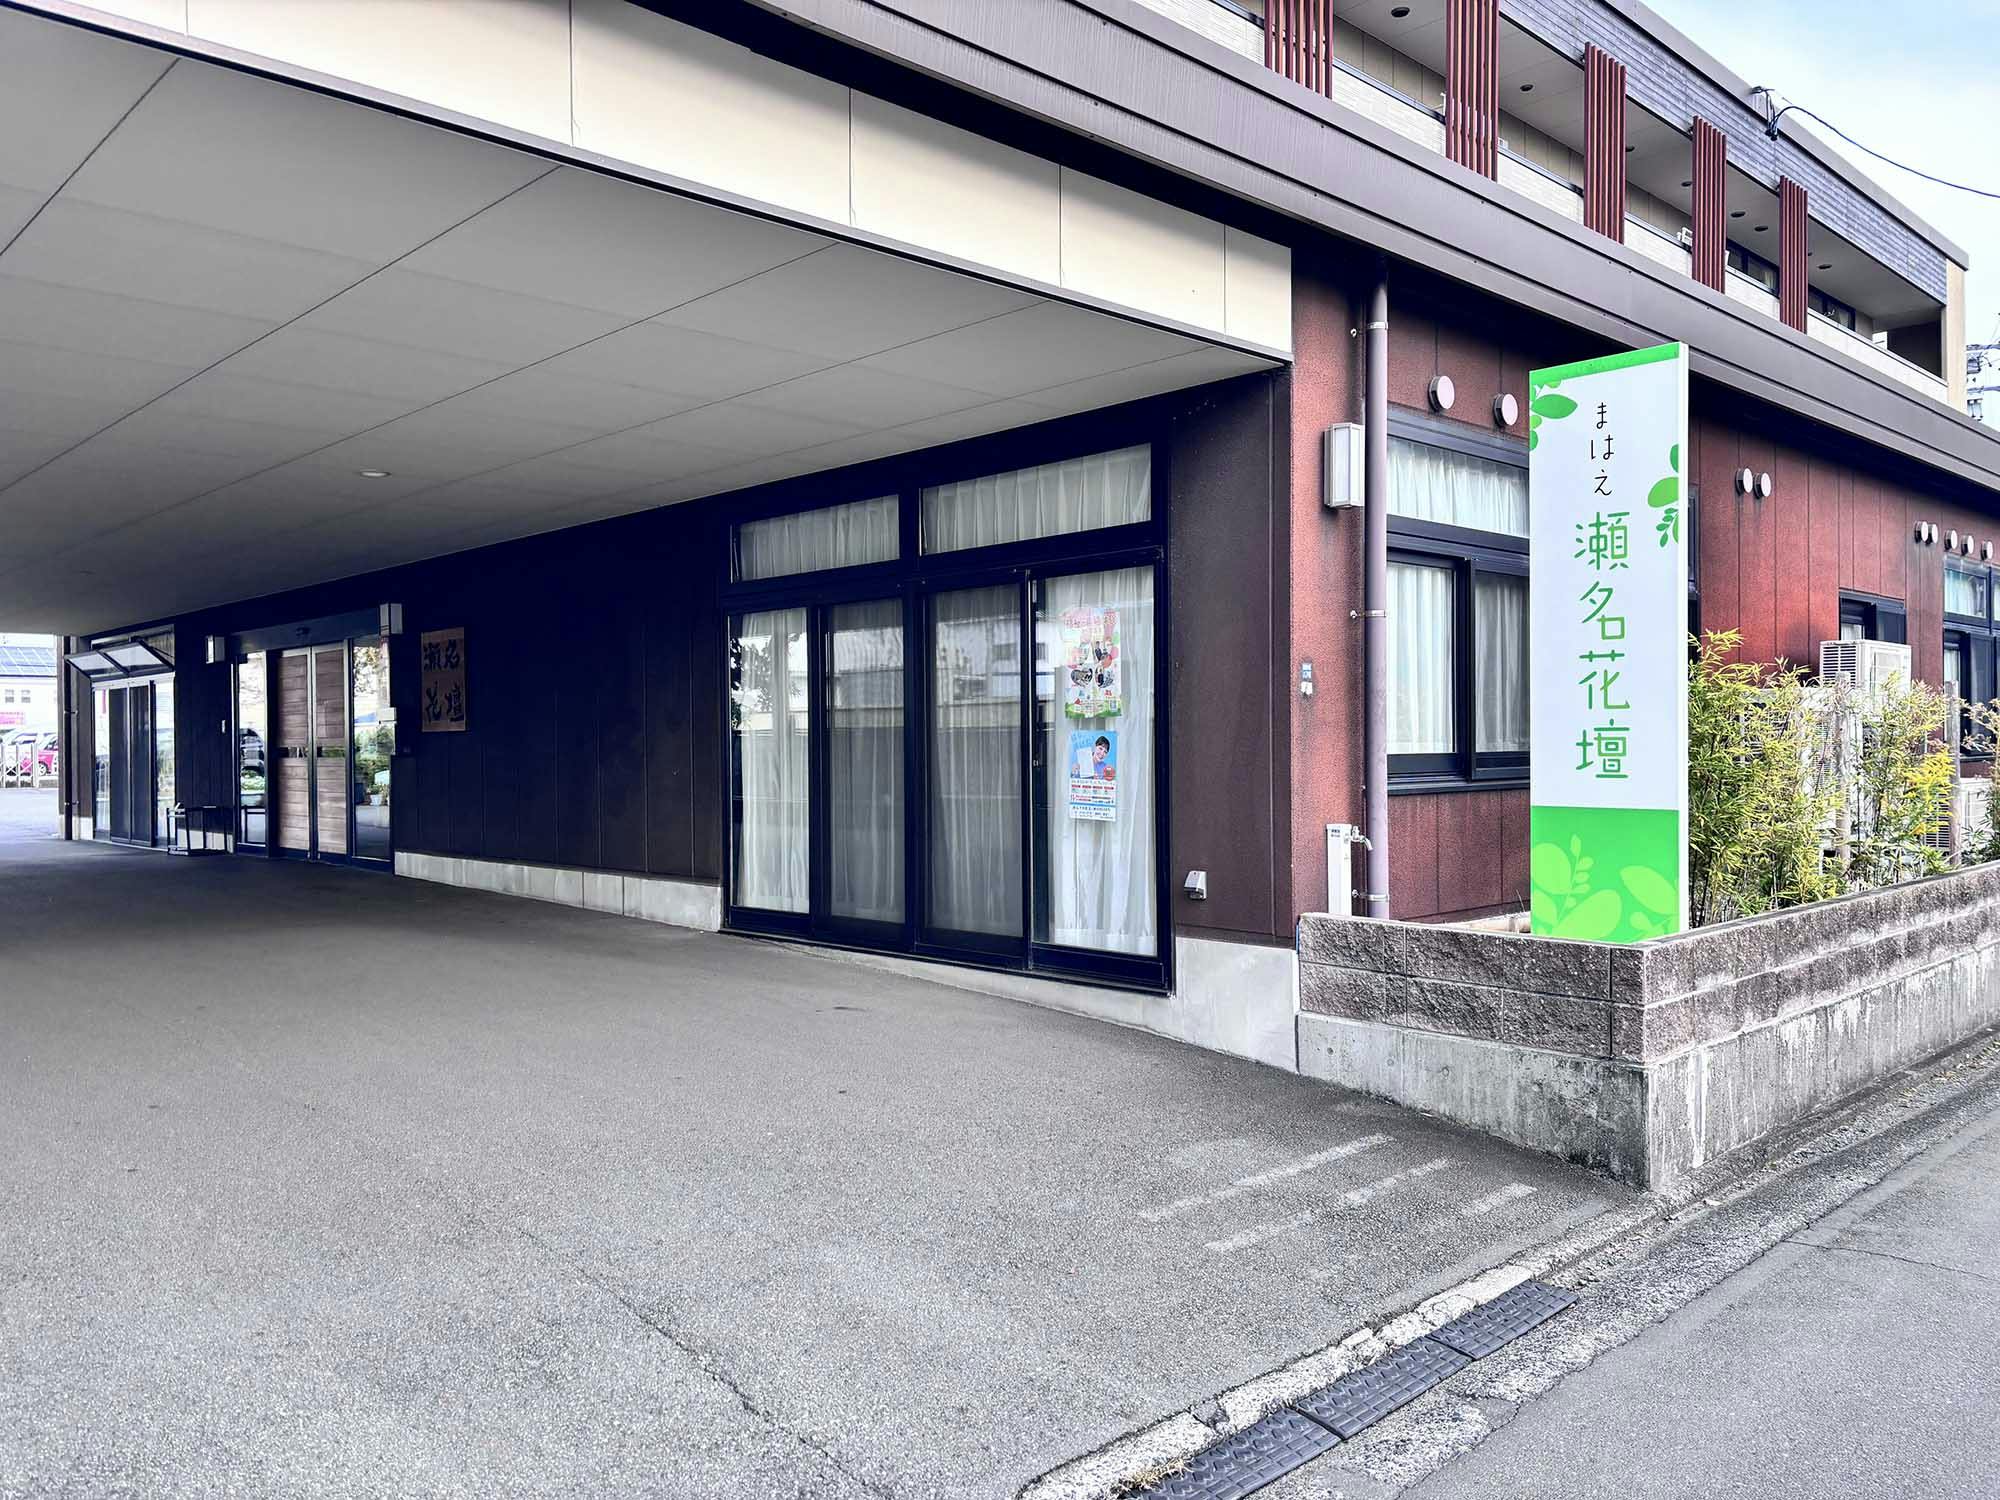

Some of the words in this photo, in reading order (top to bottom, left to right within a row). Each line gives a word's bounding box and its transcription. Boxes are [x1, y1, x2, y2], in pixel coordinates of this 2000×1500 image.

[1590, 402, 1614, 496] まはえ
[1573, 511, 1631, 779] 瀬名花壇
